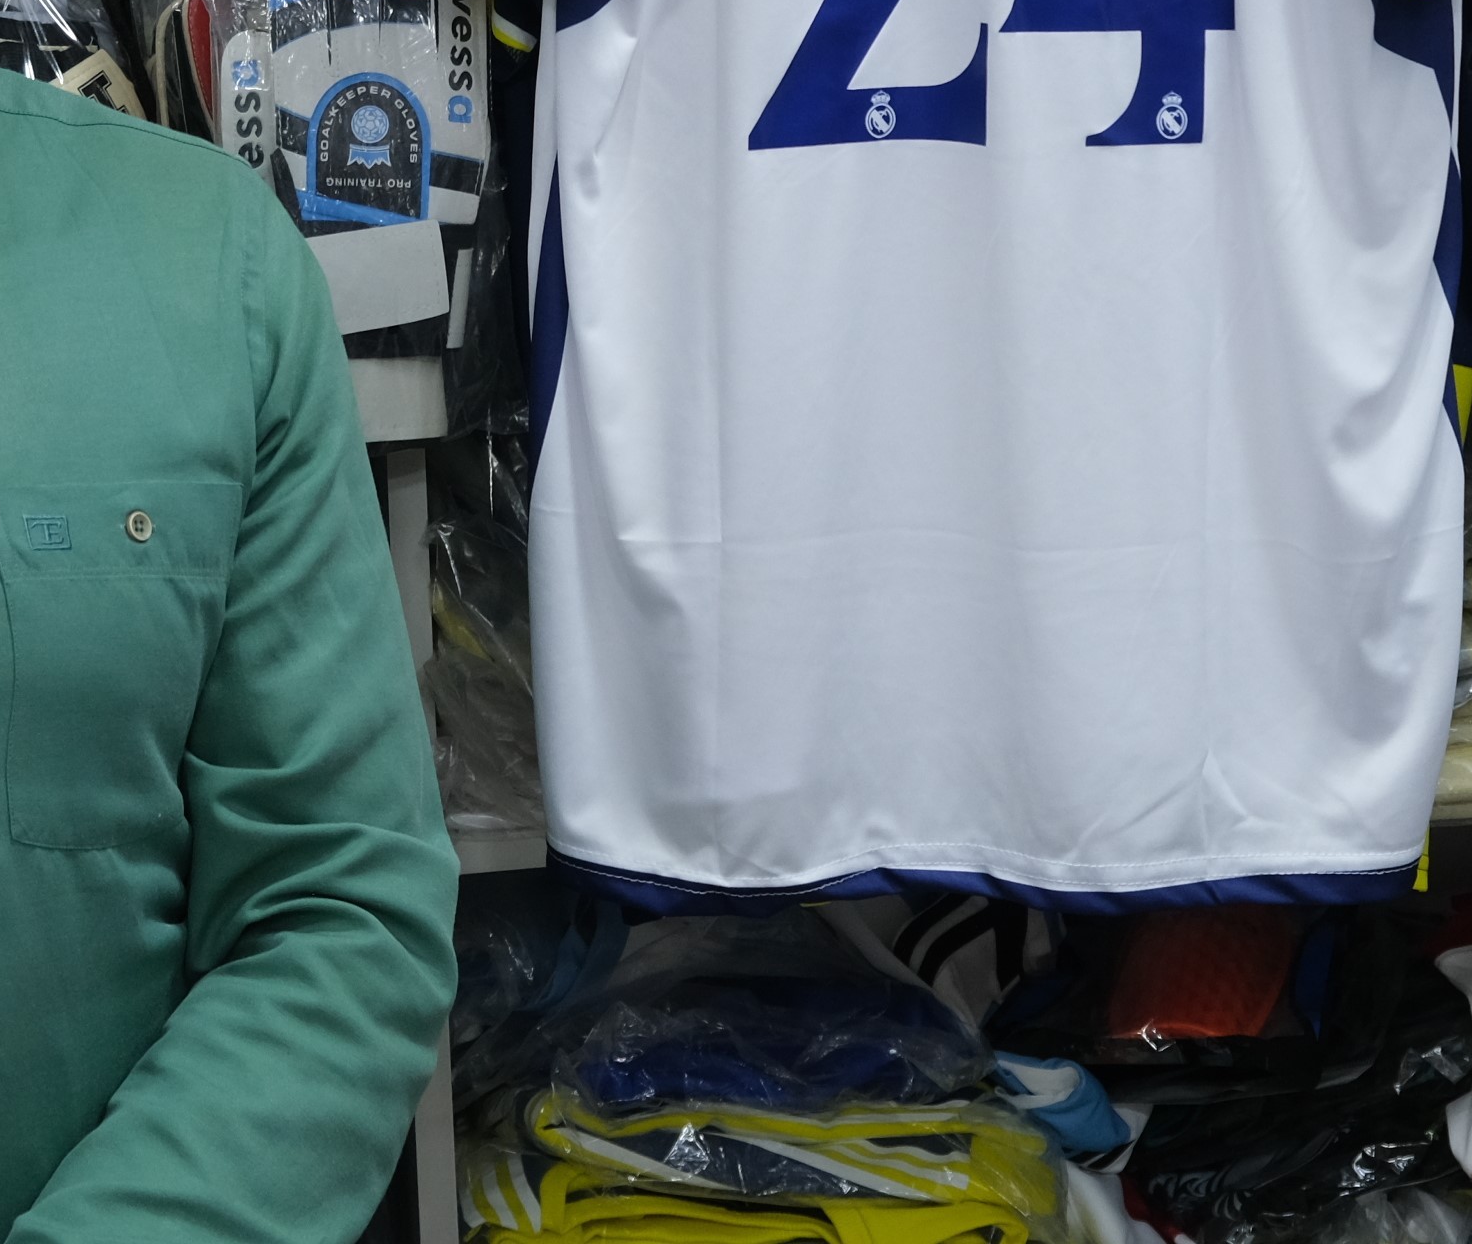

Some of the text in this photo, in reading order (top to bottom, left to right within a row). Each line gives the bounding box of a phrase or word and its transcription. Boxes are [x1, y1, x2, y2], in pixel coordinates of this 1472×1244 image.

[320, 86, 418, 163] GOALKEEPER GLOVES
[326, 177, 412, 188] PRO TRAINING
